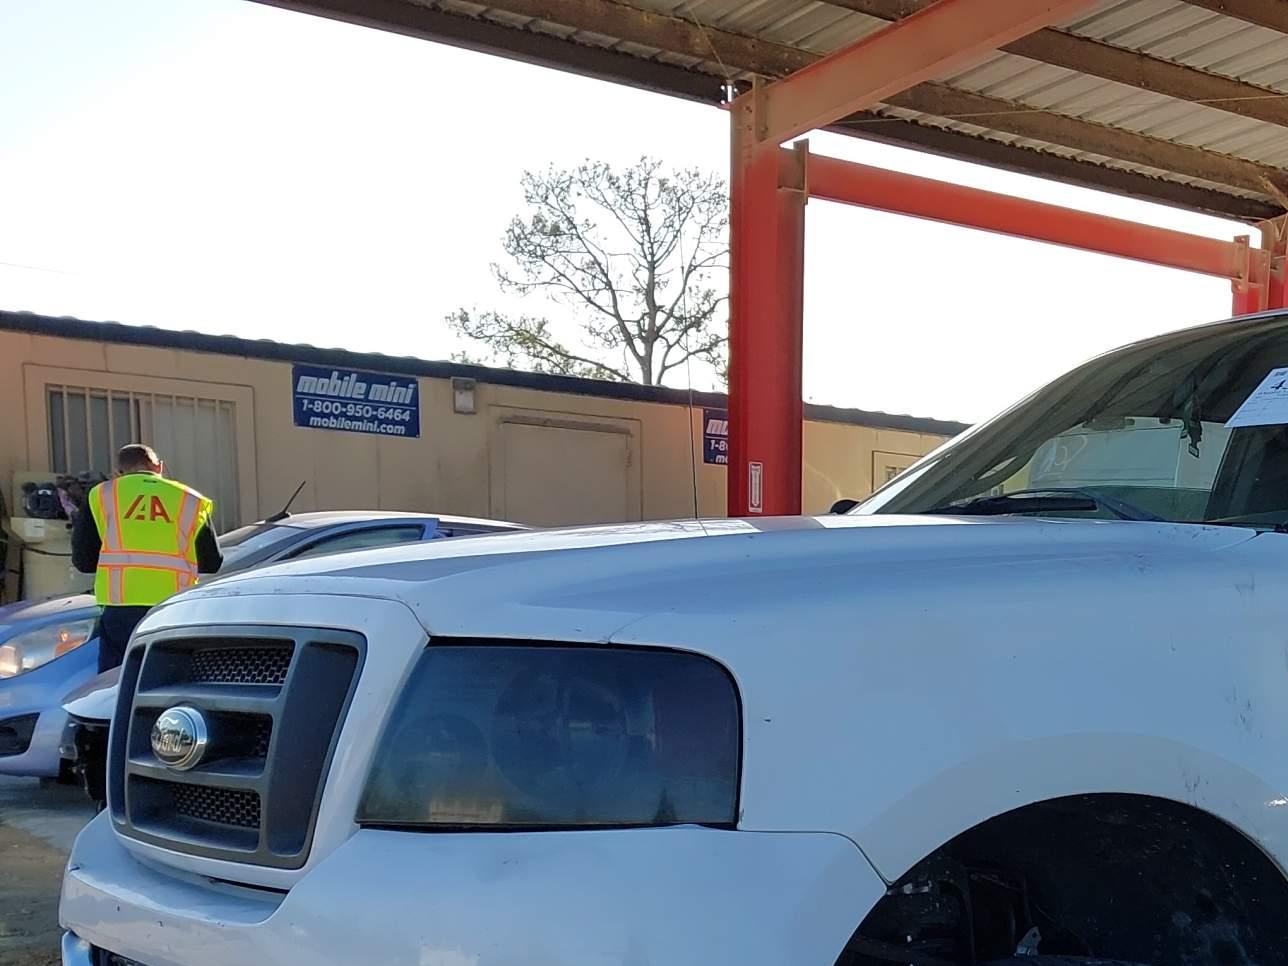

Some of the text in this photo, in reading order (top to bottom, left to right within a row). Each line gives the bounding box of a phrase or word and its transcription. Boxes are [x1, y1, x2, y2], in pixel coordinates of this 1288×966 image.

[296, 370, 416, 404] mobile mini
[302, 399, 411, 422] 1-800-950-6464
[309, 416, 406, 435] mobilemini.com
